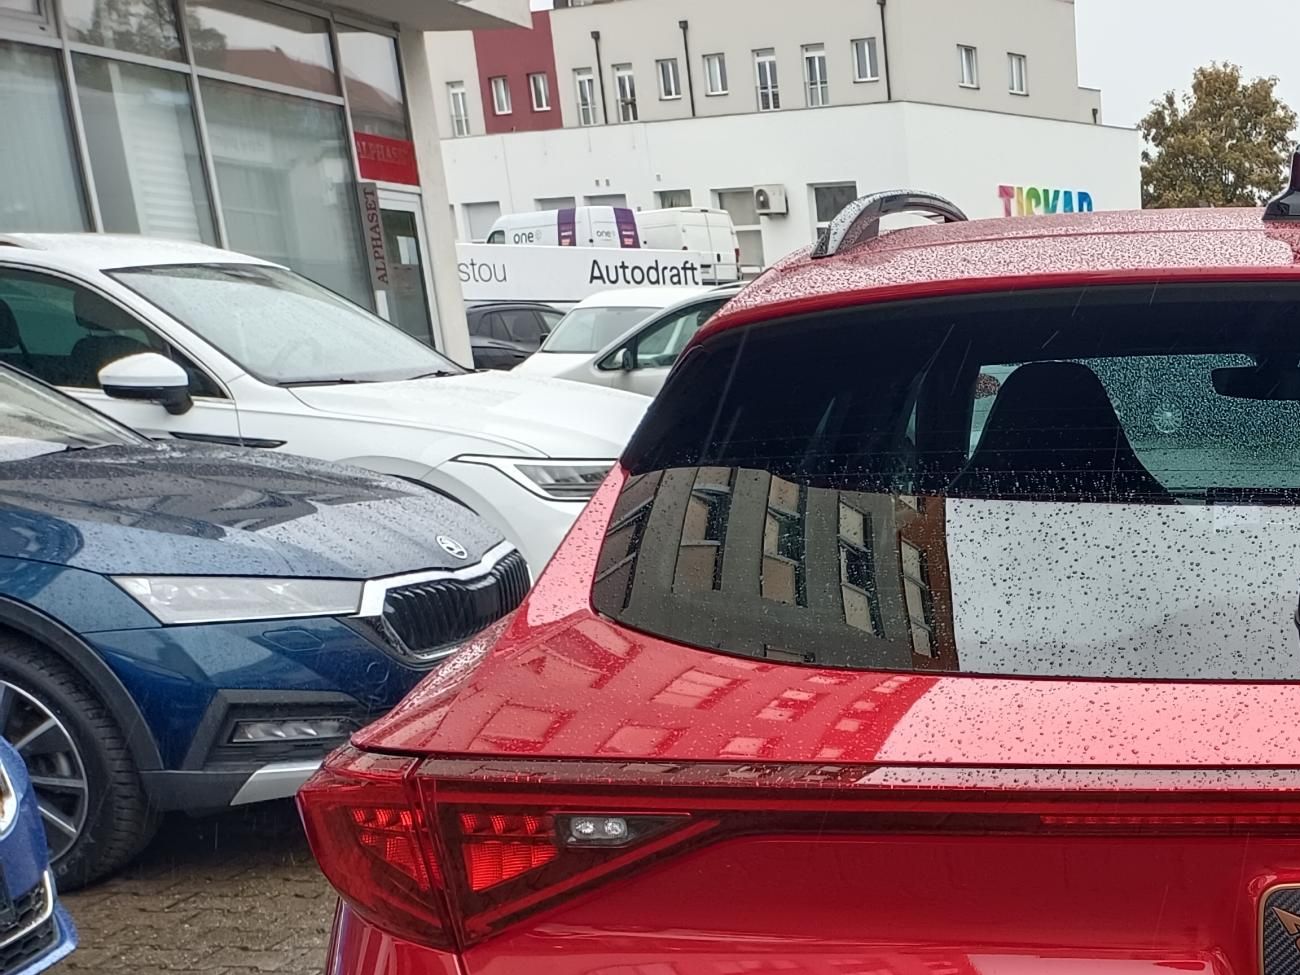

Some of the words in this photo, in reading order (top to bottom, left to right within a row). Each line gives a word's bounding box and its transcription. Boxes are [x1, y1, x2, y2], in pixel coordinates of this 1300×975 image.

[363, 187, 389, 284] ALPHASET
[513, 230, 535, 245] one
[458, 258, 508, 283] stou
[589, 258, 699, 286] Autodraft
